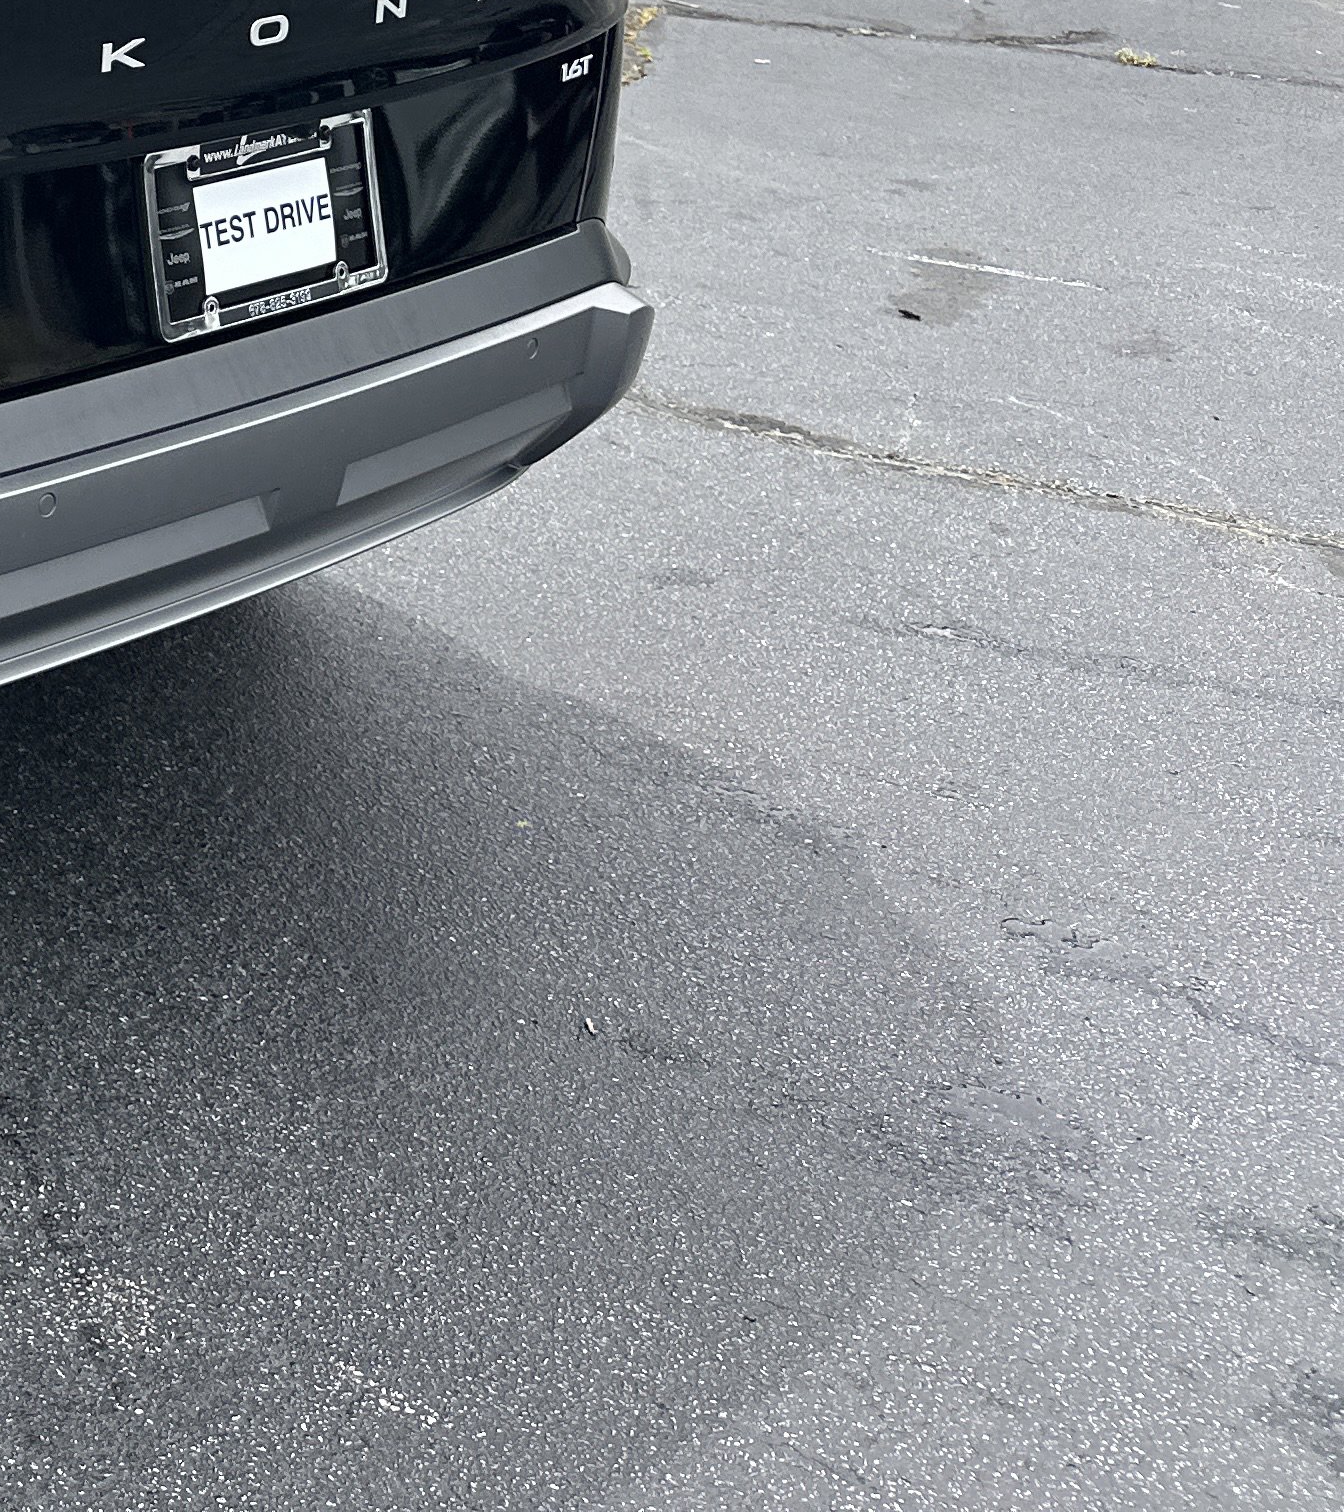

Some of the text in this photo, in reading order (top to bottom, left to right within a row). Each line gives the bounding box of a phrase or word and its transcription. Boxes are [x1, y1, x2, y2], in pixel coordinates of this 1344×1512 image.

[199, 193, 331, 250] TEST DRIVE
[166, 252, 191, 266] Jeep
